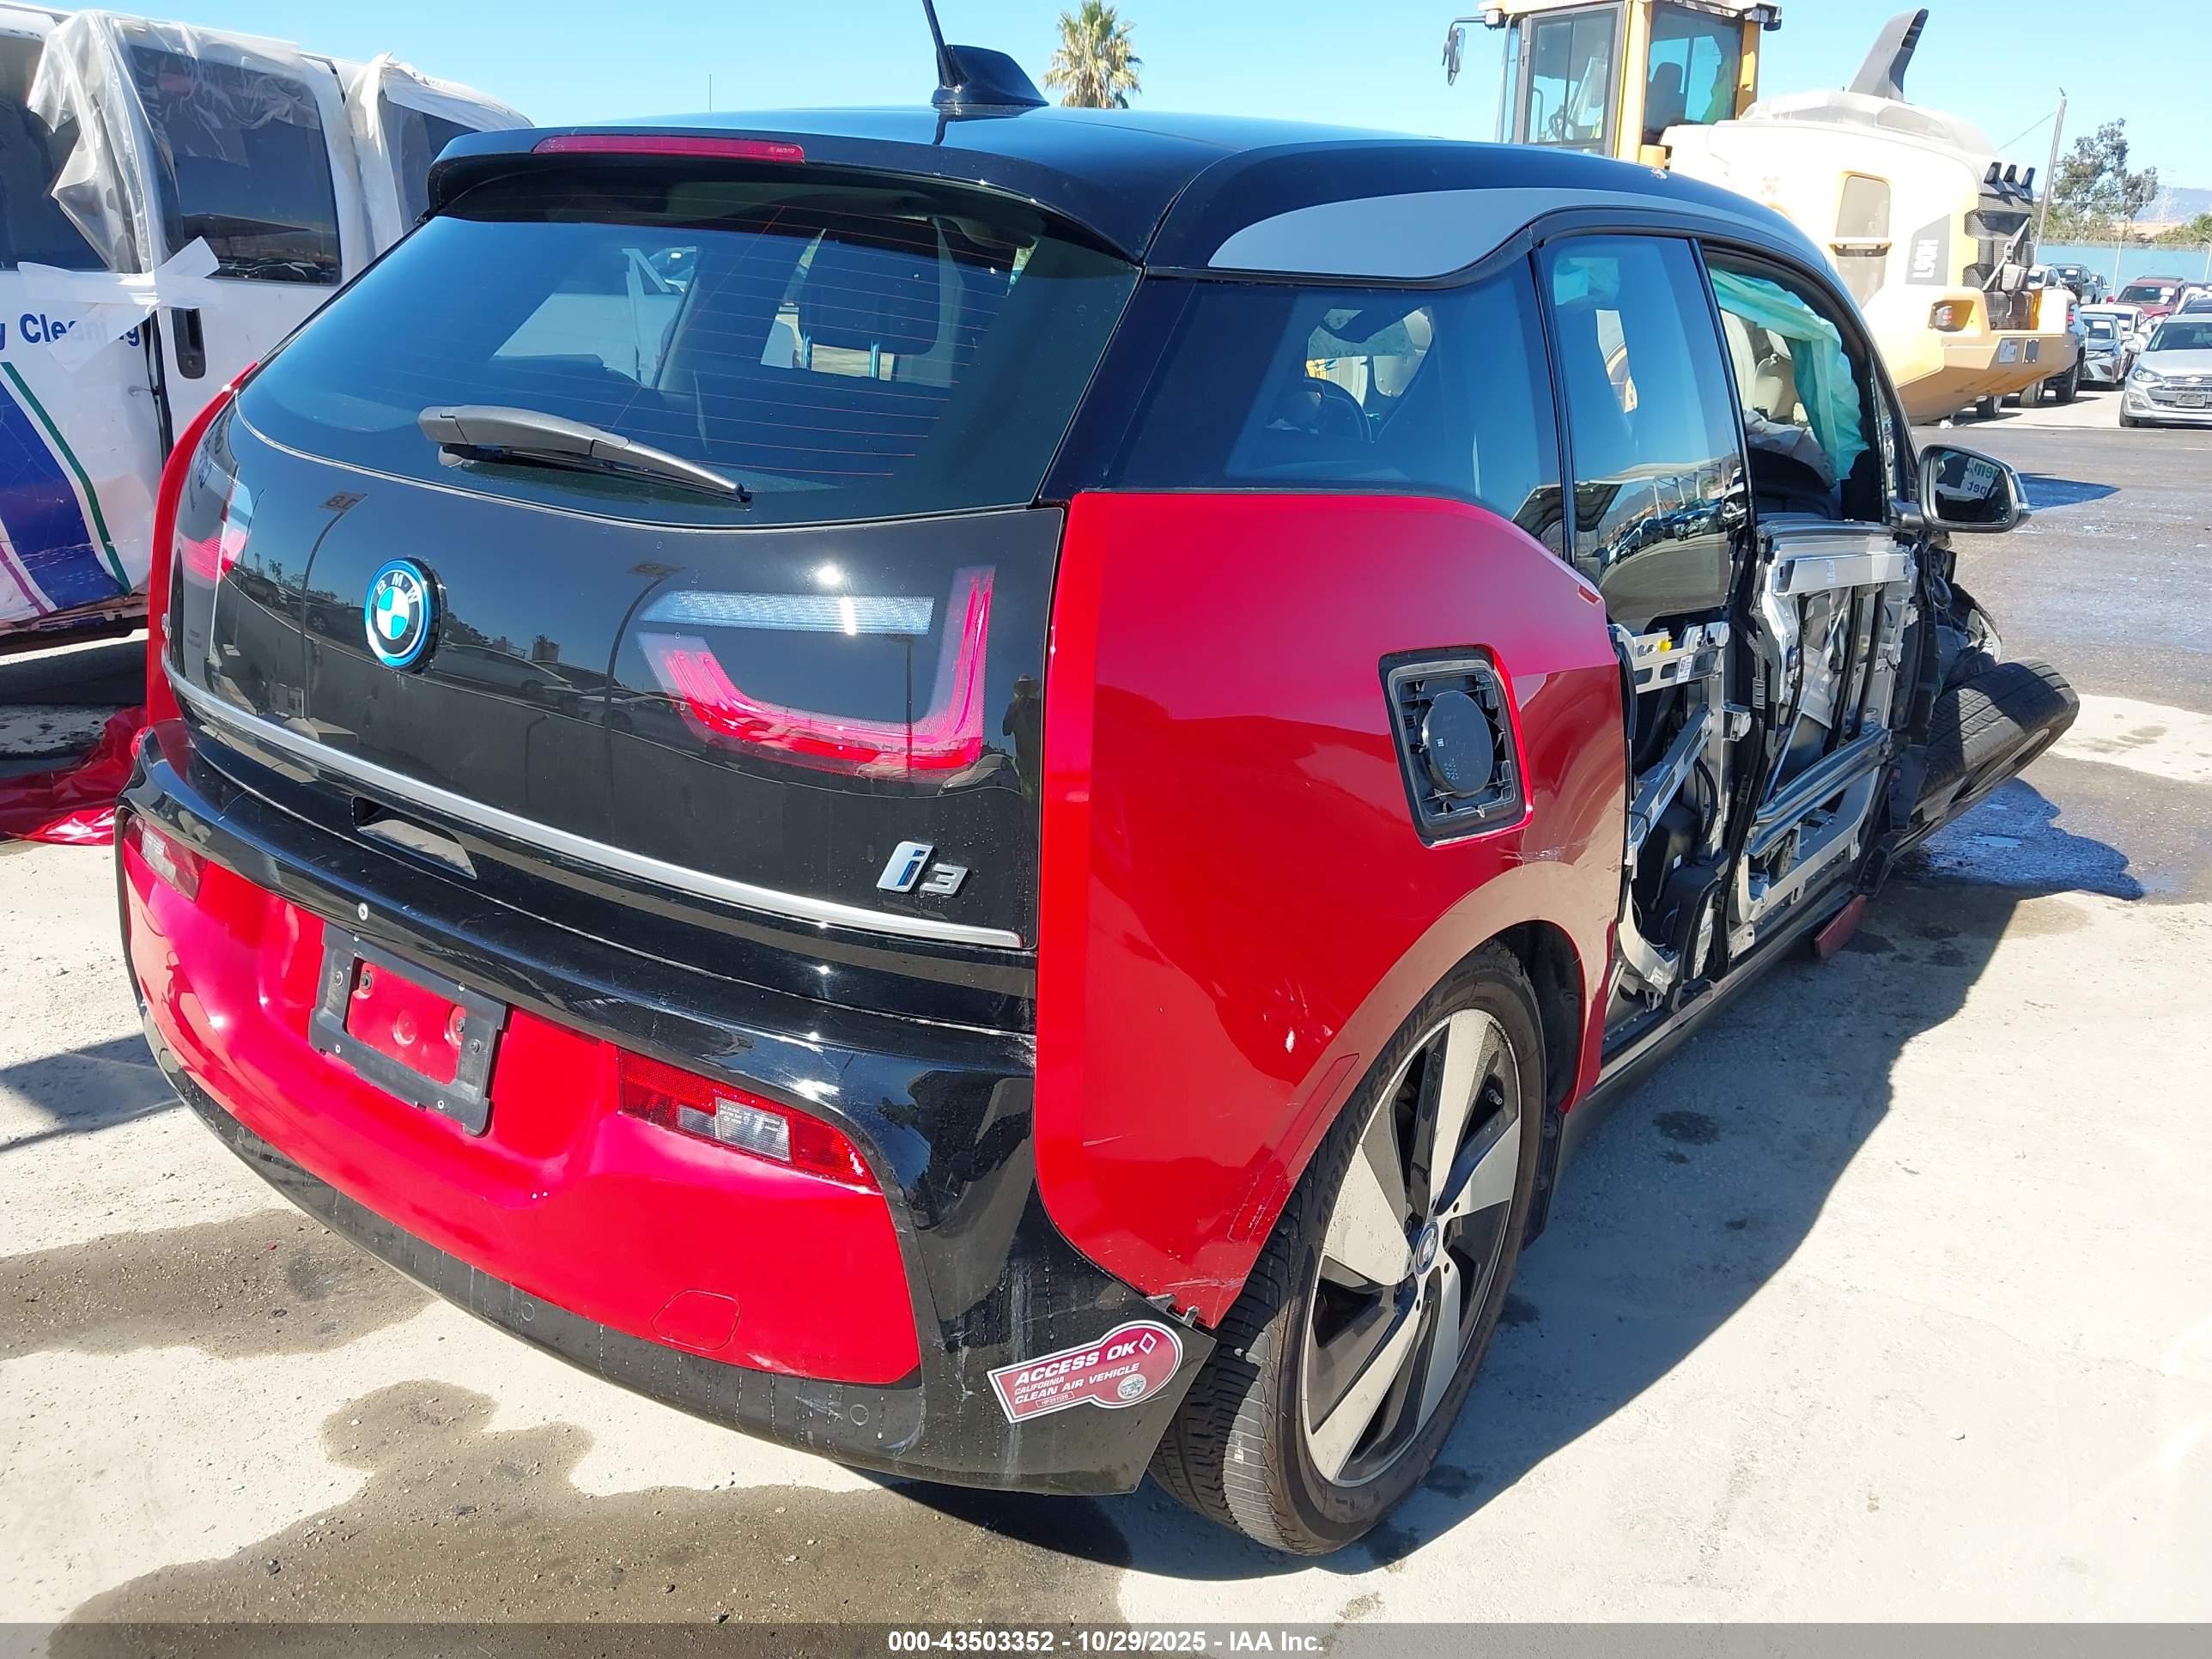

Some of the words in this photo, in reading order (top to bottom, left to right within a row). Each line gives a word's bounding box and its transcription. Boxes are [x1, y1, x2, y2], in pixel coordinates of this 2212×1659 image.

[376, 572, 421, 605] BMW
[877, 841, 969, 895] i3
[1014, 1351, 1100, 1387] ACCESS
[1106, 1340, 1139, 1361] OK
[1014, 1387, 1058, 1405] CLEAN
[1061, 1378, 1085, 1393] AIR
[1089, 1363, 1140, 1384] VEHICLE
[1014, 1376, 1065, 1395] CALIFORNIA
